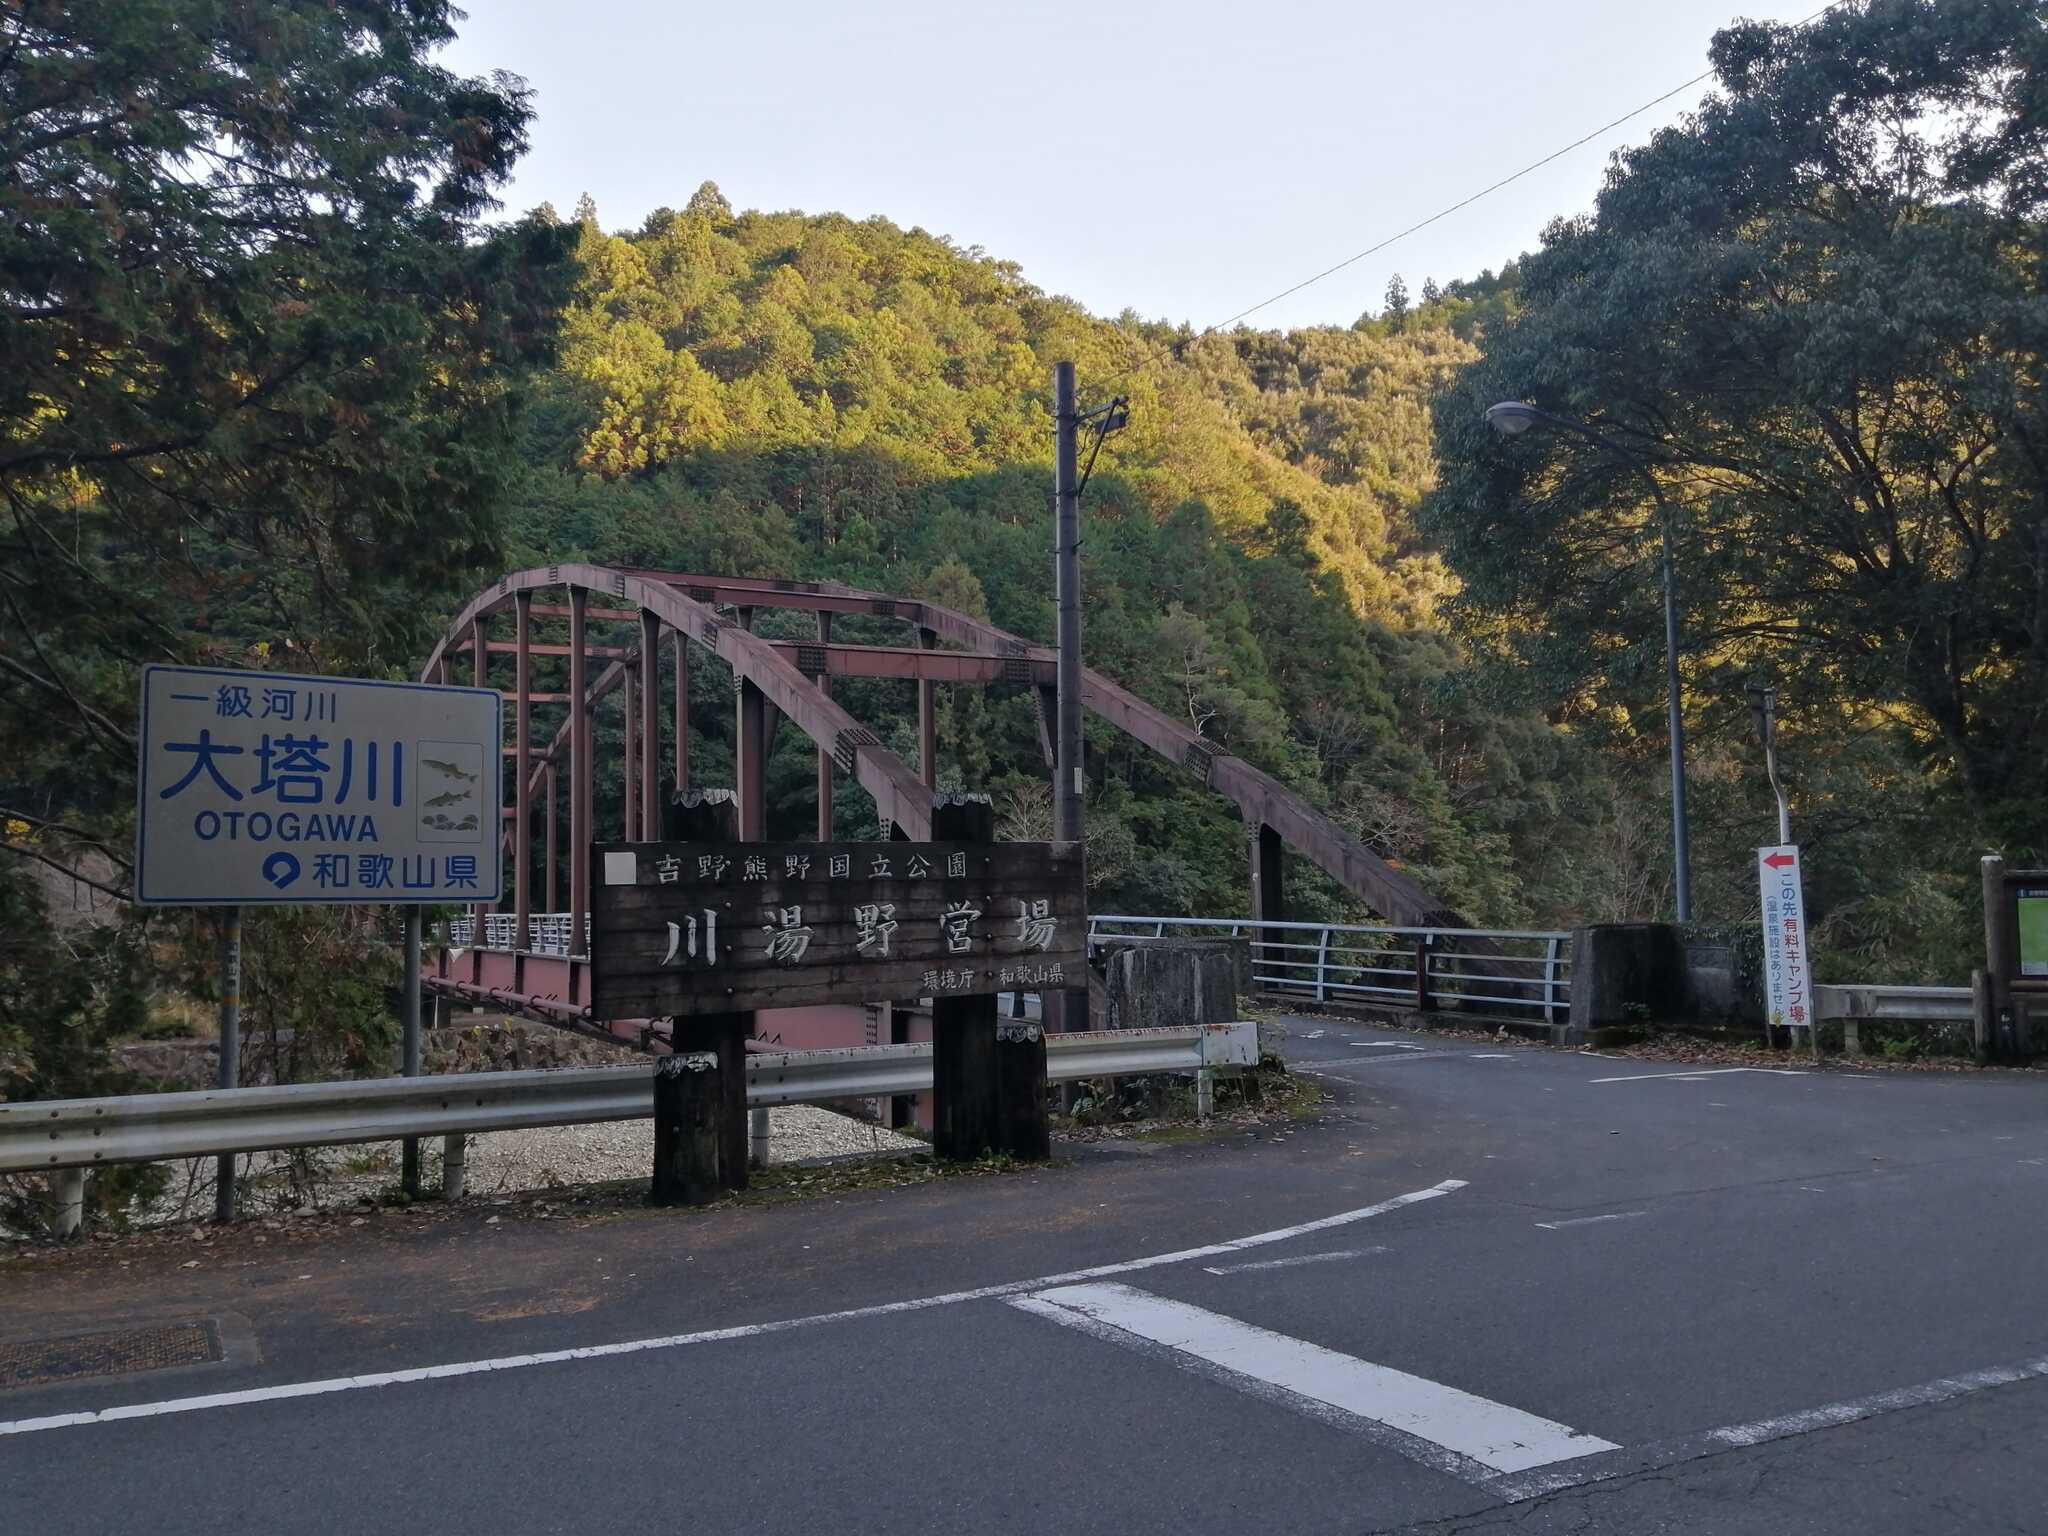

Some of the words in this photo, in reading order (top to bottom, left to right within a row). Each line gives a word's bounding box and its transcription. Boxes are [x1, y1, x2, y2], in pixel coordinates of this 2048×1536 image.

[170, 684, 337, 723] 一級河川
[160, 729, 403, 807] 大塔川
[195, 810, 378, 842] OTOGAWA
[312, 853, 478, 889] 和歌山県
[656, 852, 967, 884] 吉野熊野国立公園
[661, 898, 1058, 968] 川湯野営場
[923, 968, 976, 991] 環境庁
[999, 962, 1066, 985] 和歌山県
